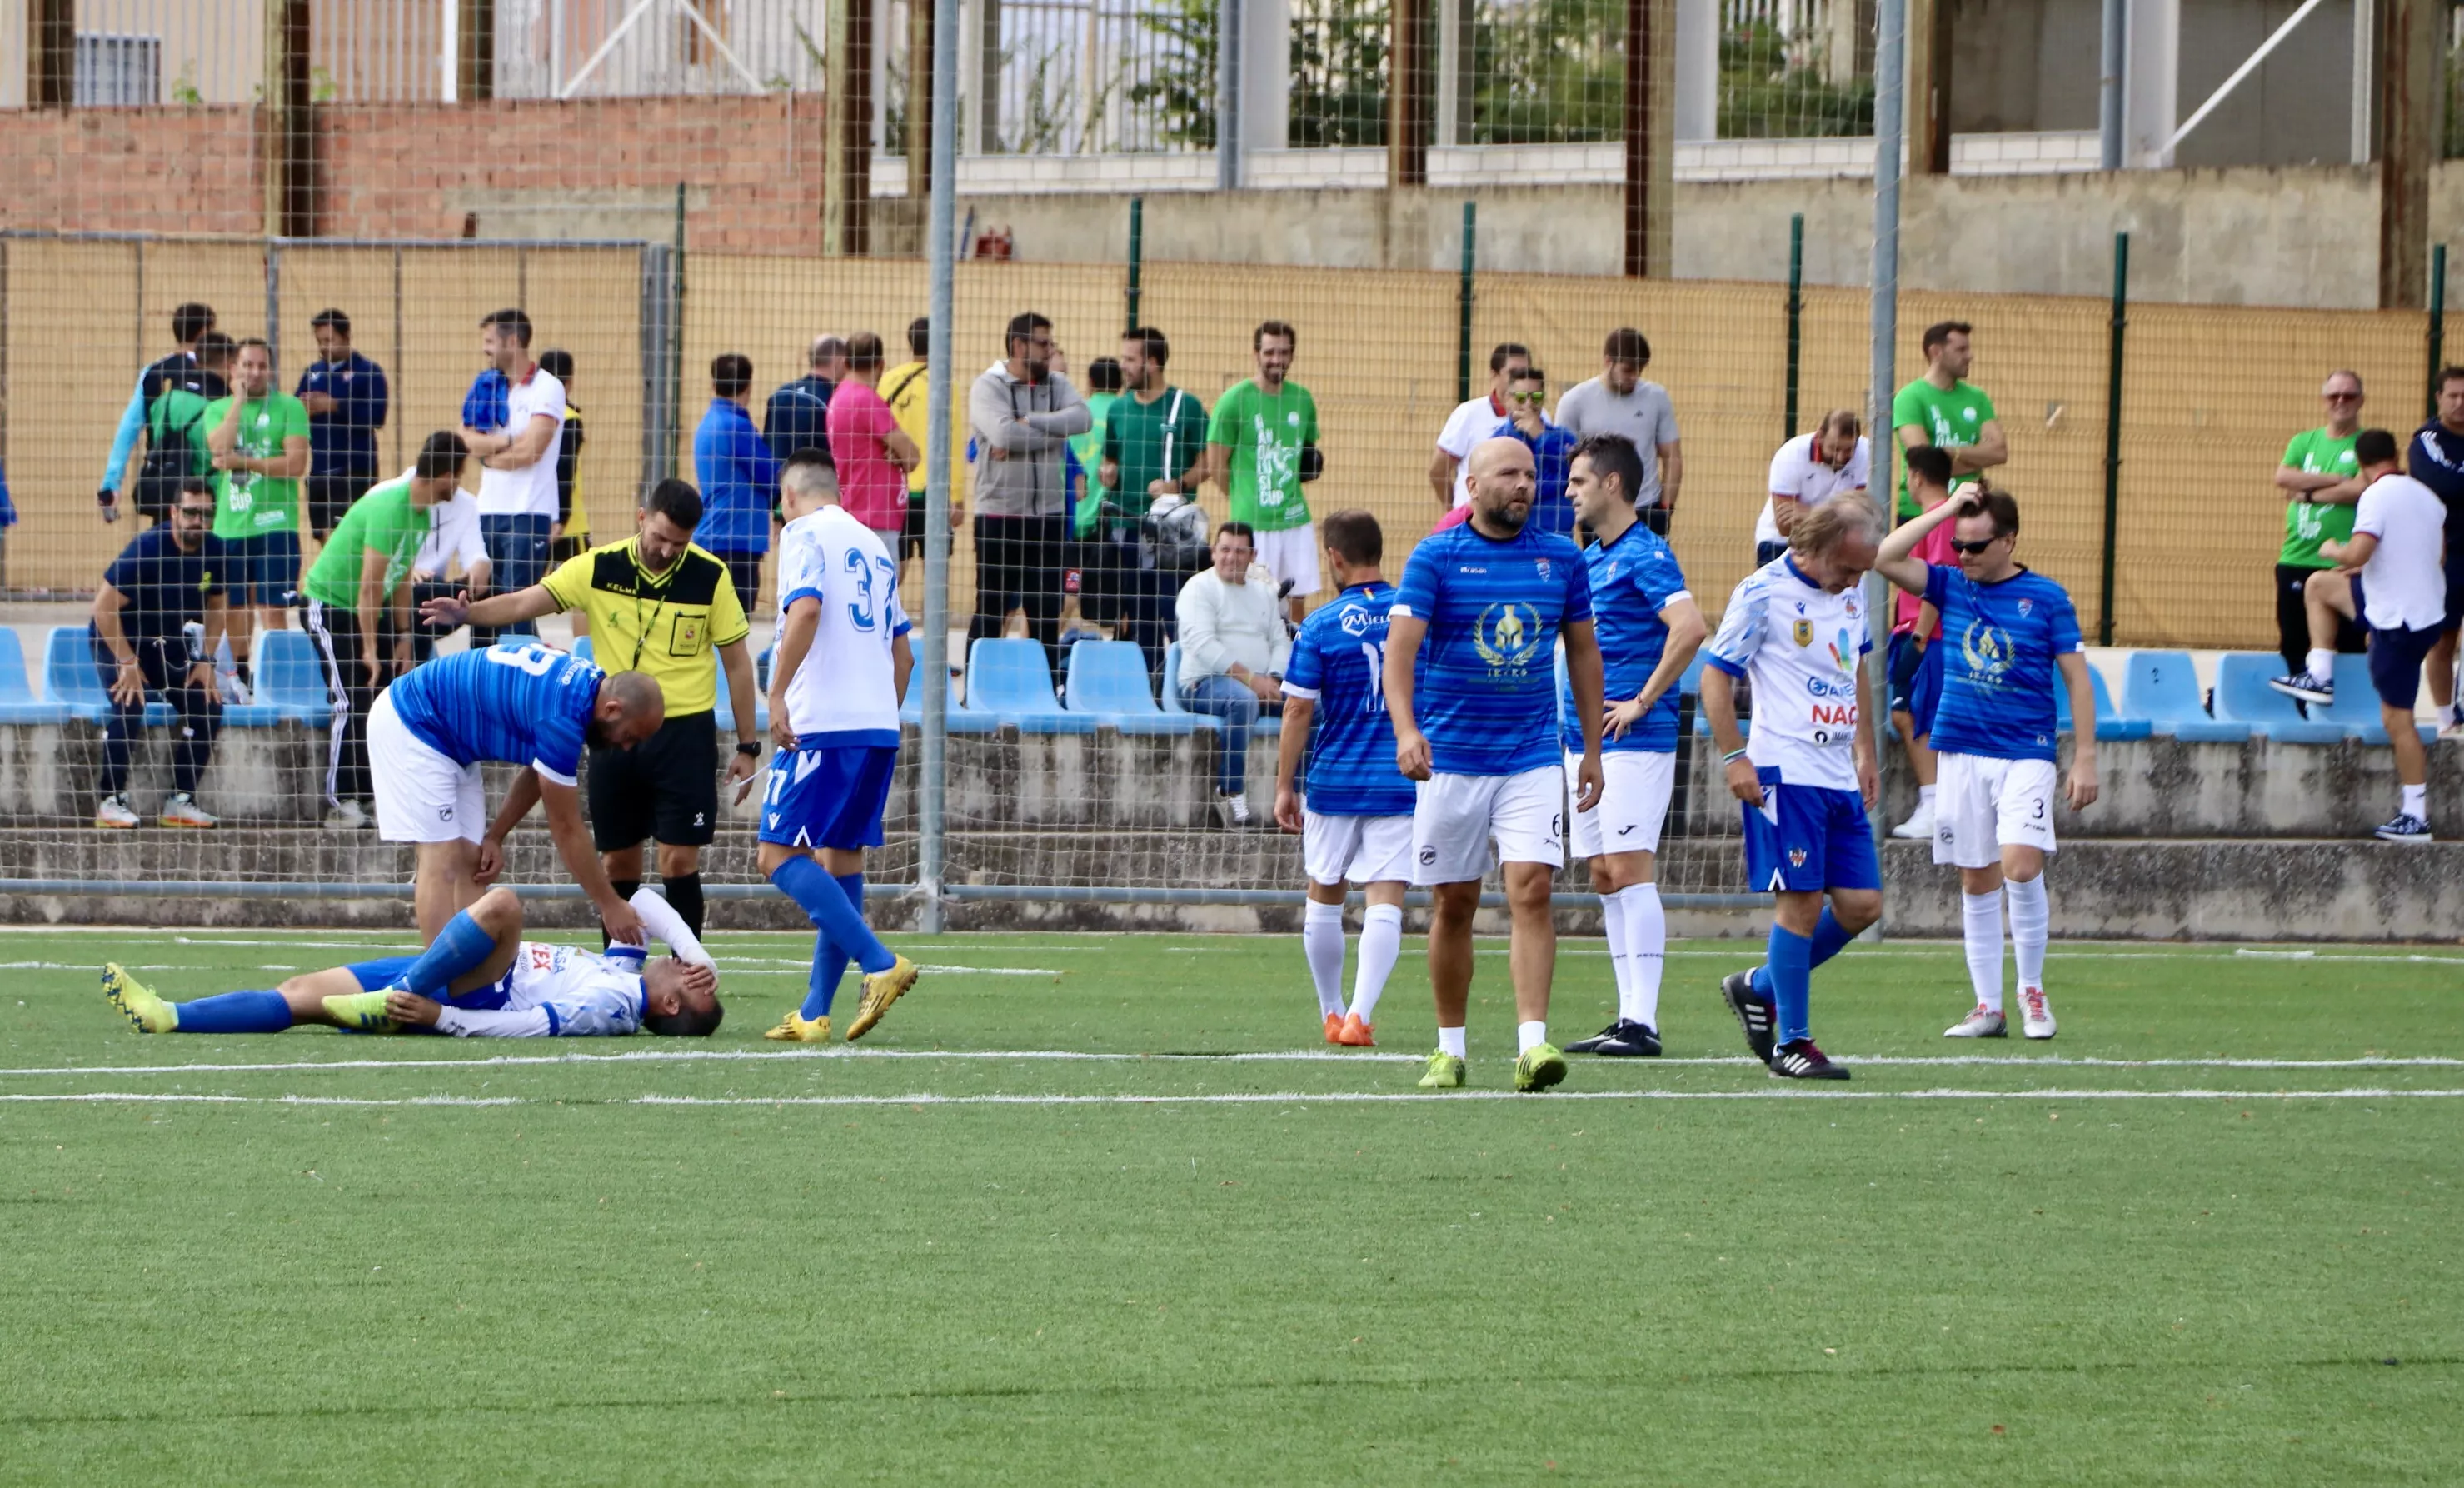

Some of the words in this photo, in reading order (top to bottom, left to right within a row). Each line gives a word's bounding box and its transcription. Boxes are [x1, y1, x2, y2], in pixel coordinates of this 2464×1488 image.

[844, 547, 898, 639] 37
[2032, 797, 2043, 819] 3
[1552, 813, 1560, 837] 6
